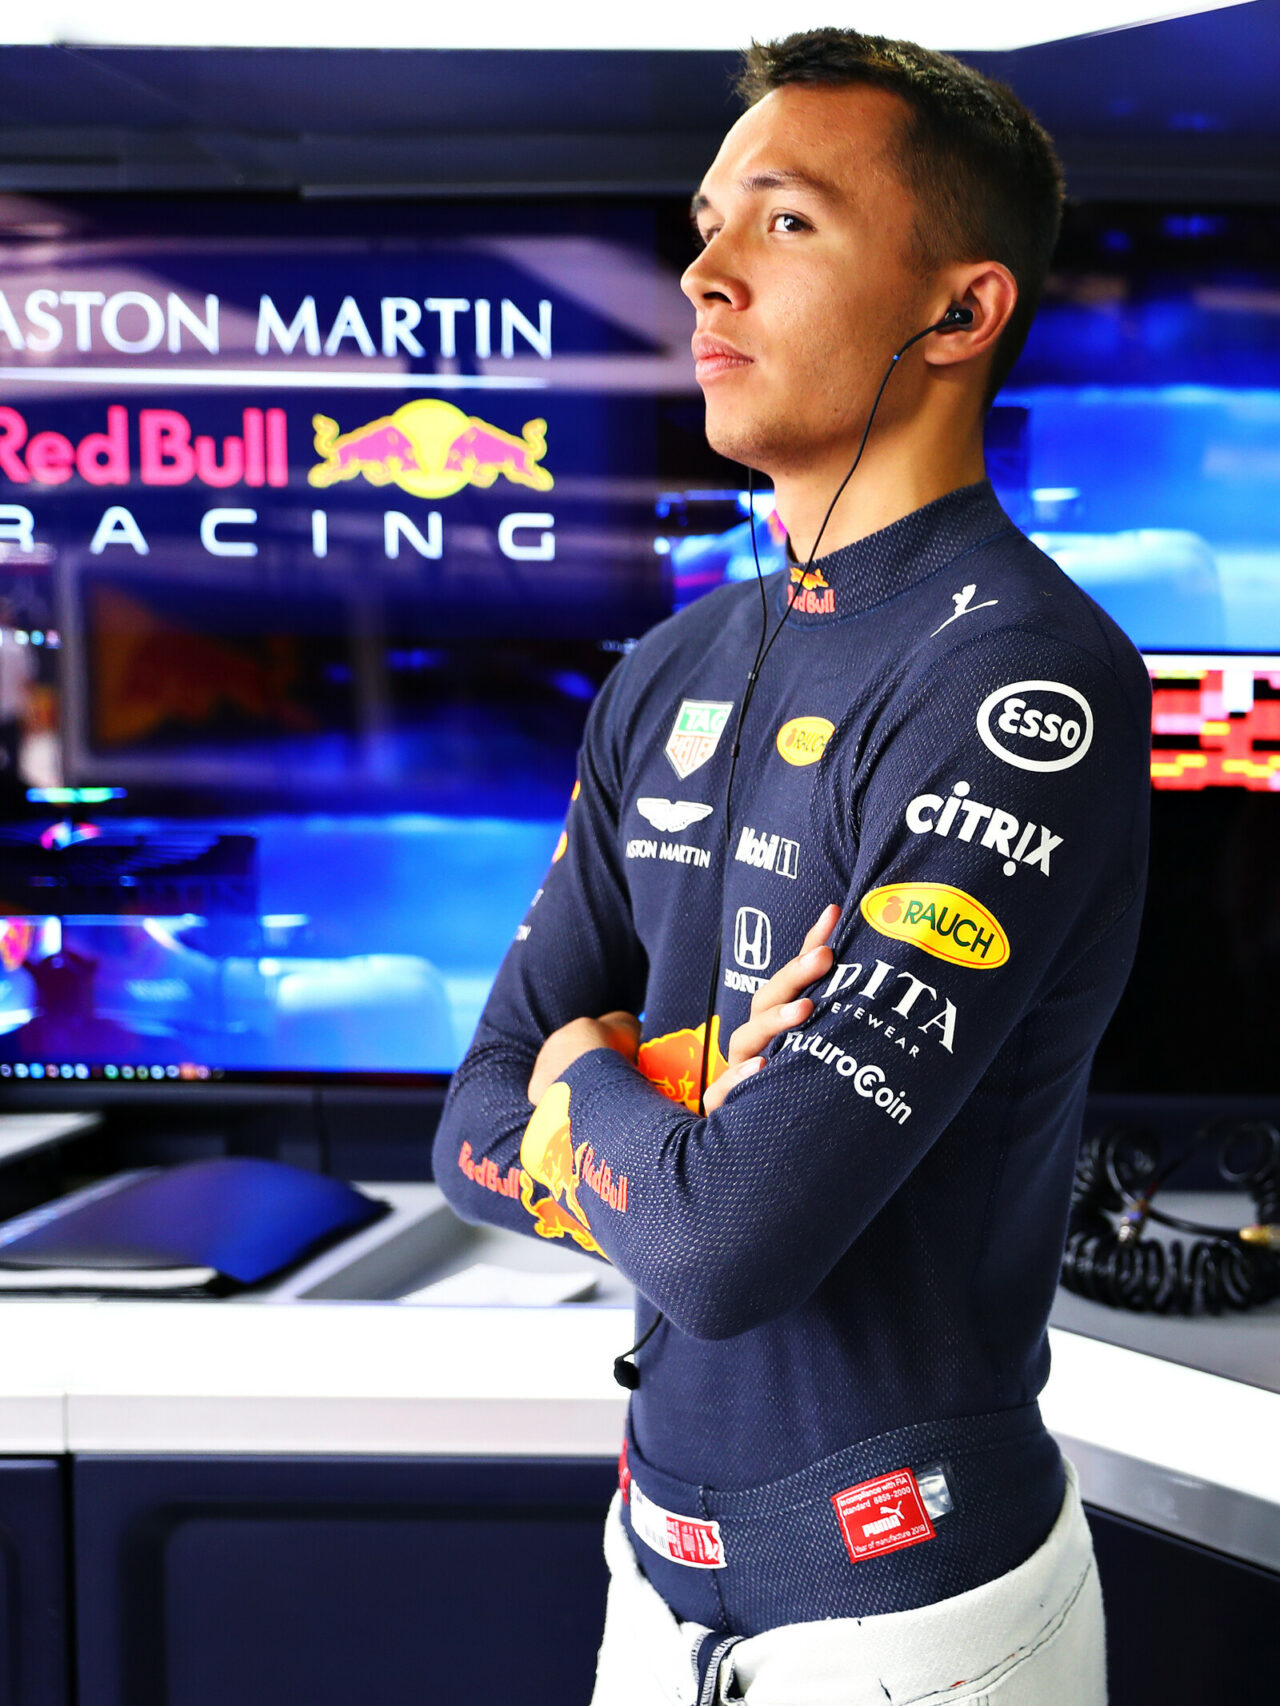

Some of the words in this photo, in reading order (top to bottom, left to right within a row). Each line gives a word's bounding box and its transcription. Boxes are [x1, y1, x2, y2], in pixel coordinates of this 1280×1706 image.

[255, 294, 553, 360] MARTIN
[139, 408, 288, 488] Bull
[0, 504, 556, 561] RACING
[685, 708, 727, 732] TAG
[659, 841, 711, 869] MARTIN
[735, 826, 780, 871] Mobil
[902, 900, 995, 959] RAUCH
[821, 959, 957, 1055] DITA
[830, 1001, 920, 1058] EYEWEAR
[843, 1500, 871, 1516] standard
[882, 1480, 896, 1491] with
[896, 1476, 908, 1486] FIA
[862, 1514, 901, 1537] PUMA
